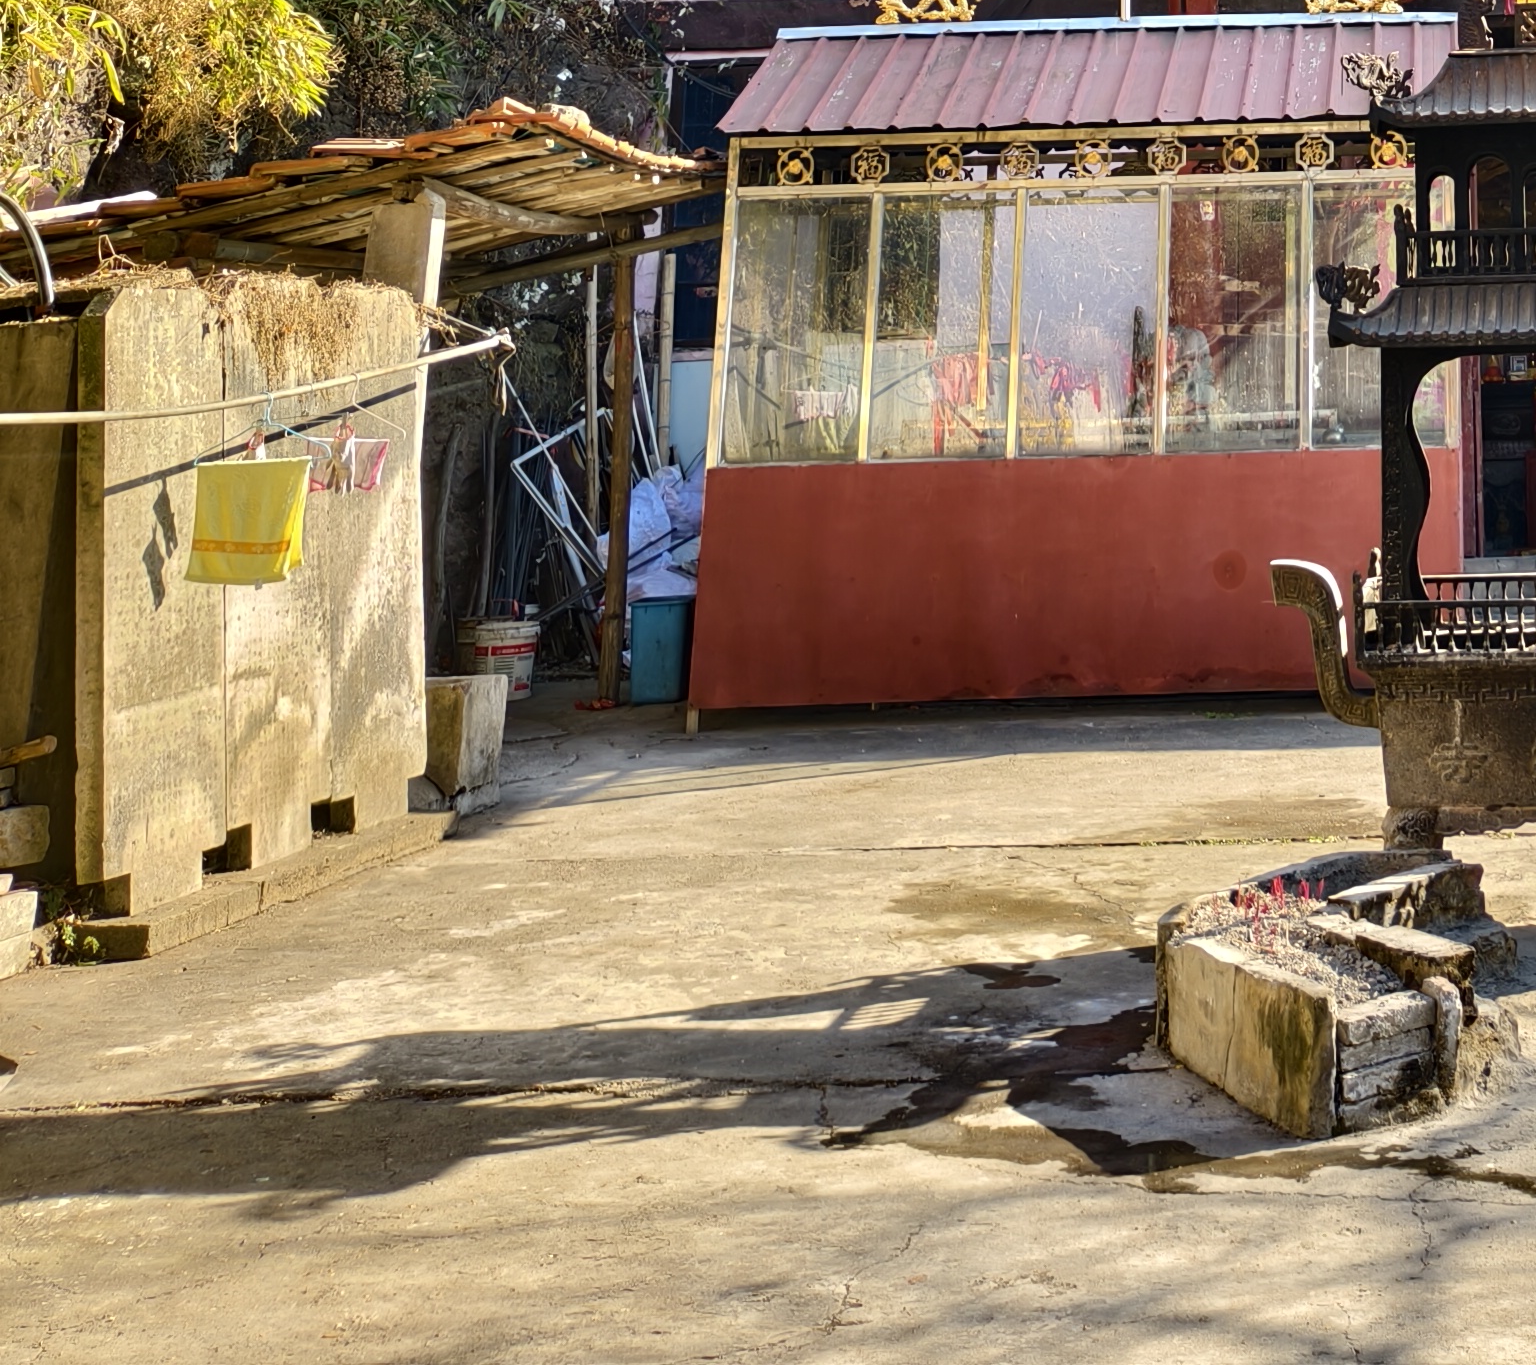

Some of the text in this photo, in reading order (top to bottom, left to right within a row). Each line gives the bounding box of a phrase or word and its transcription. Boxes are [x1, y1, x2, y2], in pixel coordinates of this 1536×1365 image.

[858, 149, 884, 178] 福
[1008, 146, 1034, 175] 福
[1154, 143, 1180, 173] 福
[1301, 136, 1328, 166] 福
